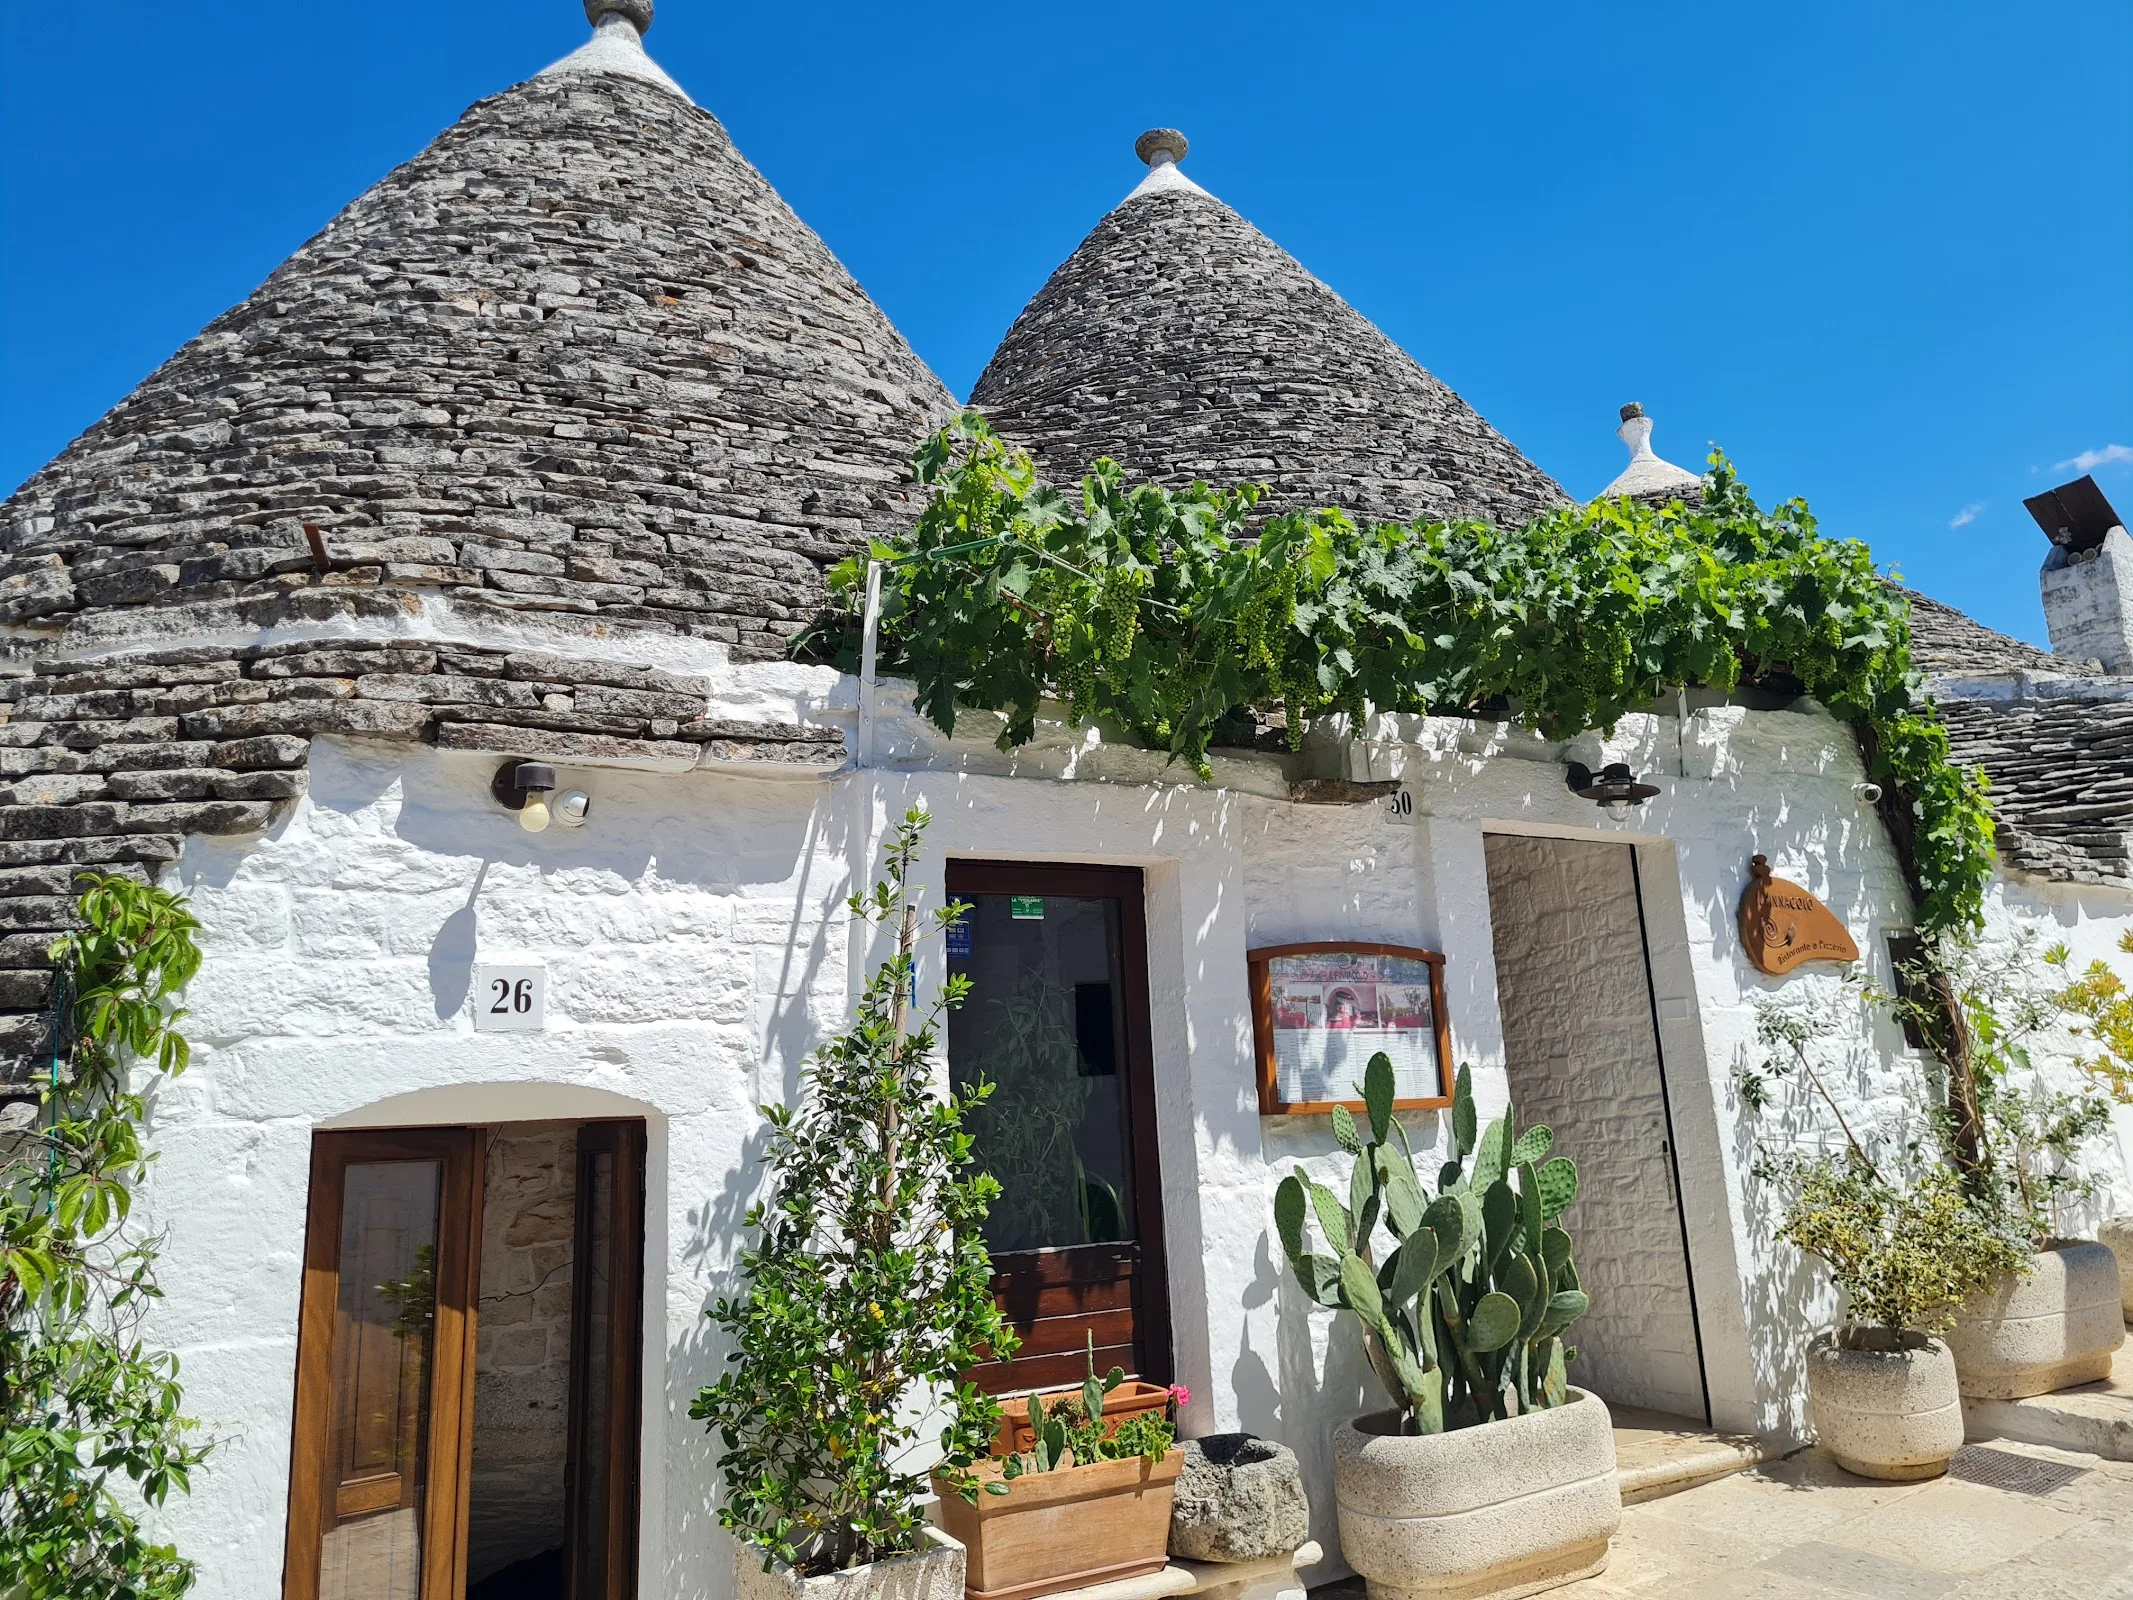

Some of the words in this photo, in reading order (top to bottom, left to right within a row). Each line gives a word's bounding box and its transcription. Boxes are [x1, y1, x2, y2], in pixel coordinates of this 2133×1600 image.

[1390, 790, 1412, 815] 30
[1777, 943, 1811, 965] Ristorante
[1819, 939, 1847, 954] Pizzeria
[490, 978, 533, 1013] 26
